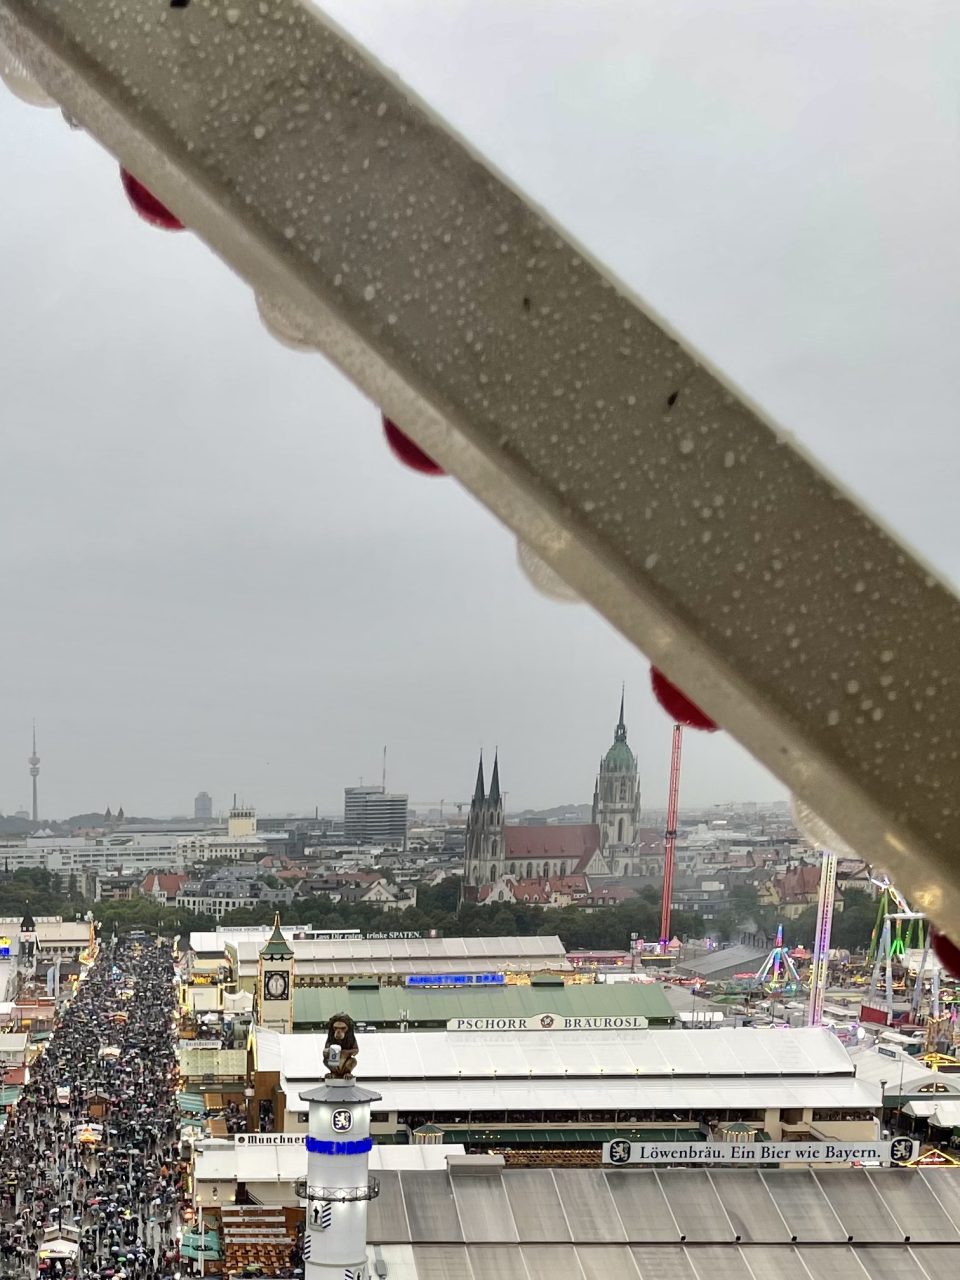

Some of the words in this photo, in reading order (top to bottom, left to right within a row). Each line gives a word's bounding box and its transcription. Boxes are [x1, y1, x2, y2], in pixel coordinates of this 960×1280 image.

[388, 931, 421, 939] SPATEN.
[457, 1019, 527, 1029] PSCHORR
[564, 1017, 641, 1028] BRÄUROSL
[640, 1145, 725, 1159] Löwenbräu.
[730, 1145, 755, 1159] Ein
[761, 1145, 791, 1159] Bier
[795, 1145, 820, 1159] wie
[825, 1145, 881, 1162] Bayern.
